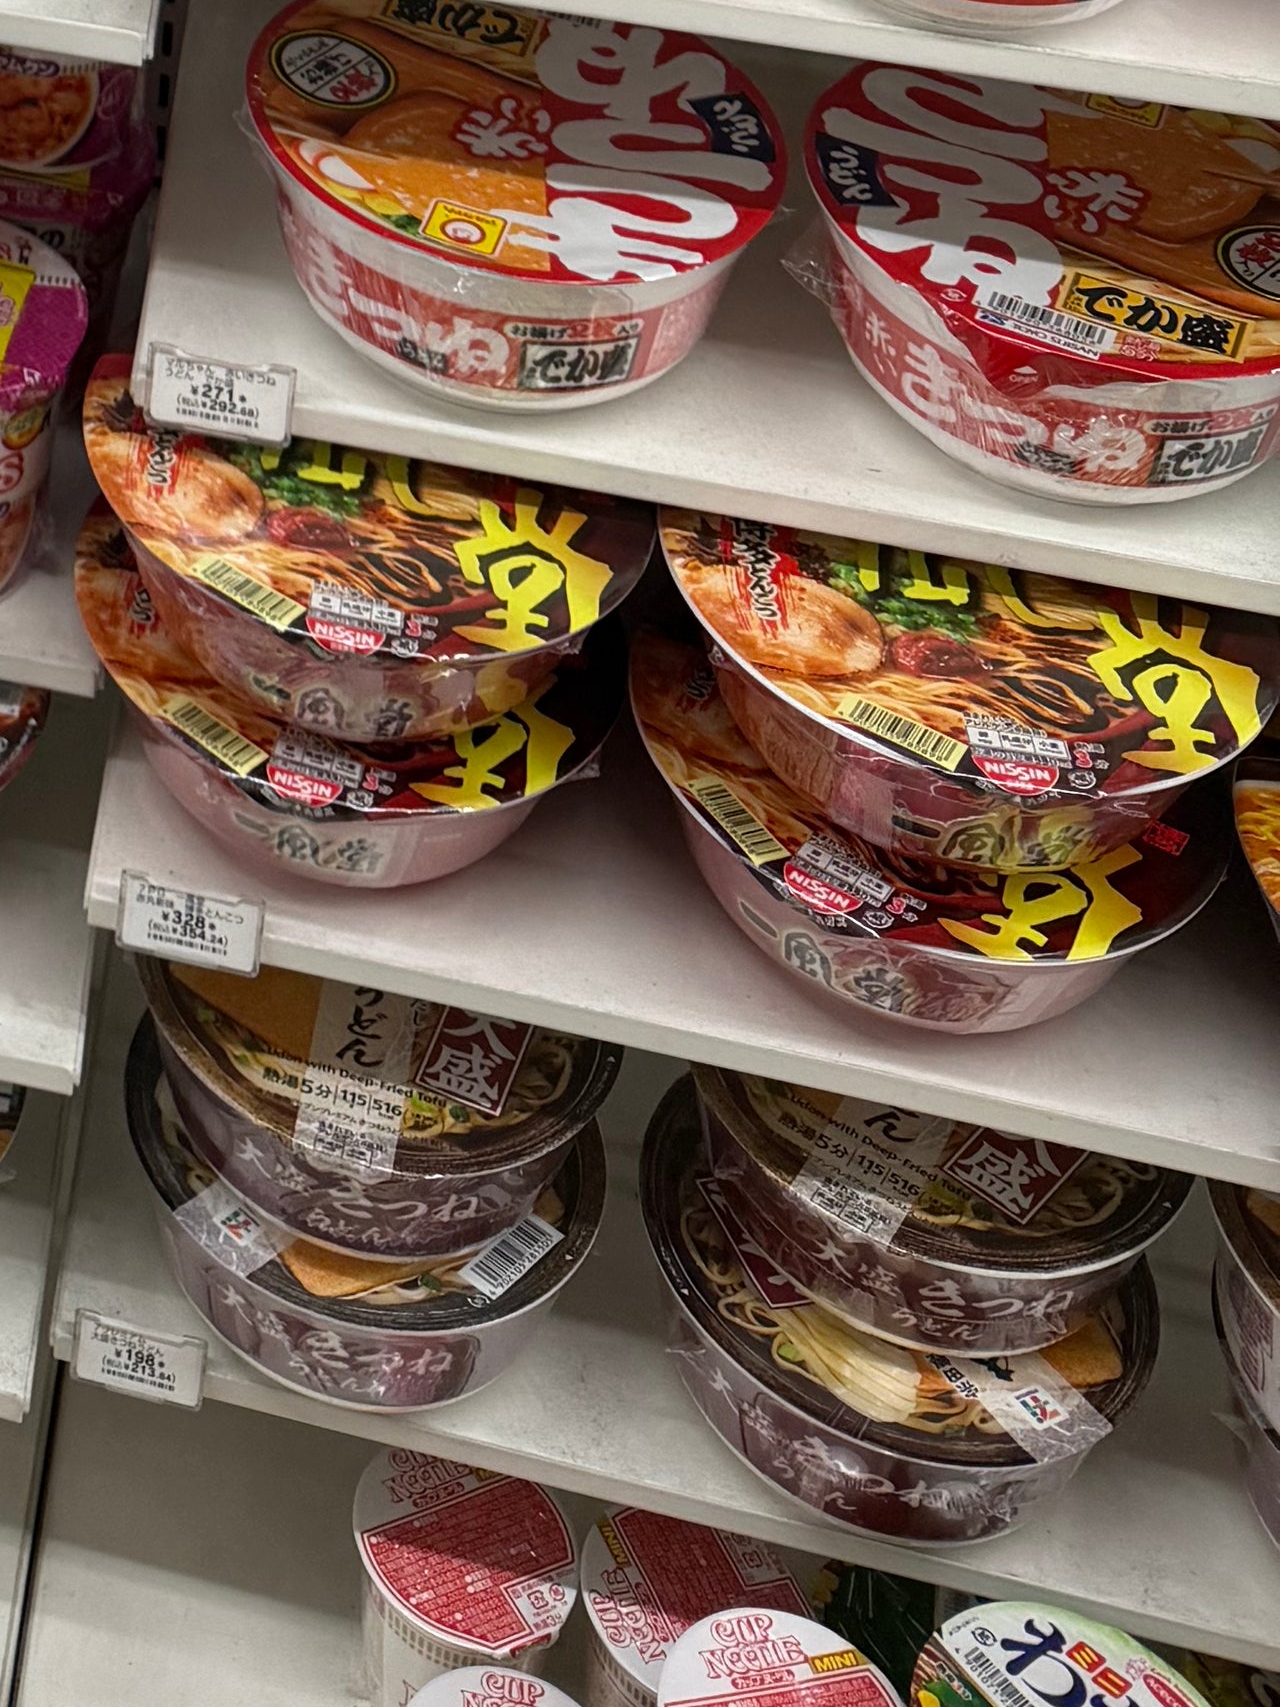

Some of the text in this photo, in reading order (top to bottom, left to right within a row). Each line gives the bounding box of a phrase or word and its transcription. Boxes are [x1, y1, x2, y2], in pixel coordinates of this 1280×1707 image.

[1076, 287, 1234, 355] でか盛
[314, 621, 376, 648] NISSIN
[273, 768, 333, 797] NISSIN
[982, 759, 1052, 784] NISSIN
[789, 868, 851, 909] NISSIN
[308, 1057, 336, 1075] with
[340, 1067, 412, 1099] Deep-Fried
[708, 1612, 775, 1643] CUP
[699, 1633, 809, 1679] NOODLE
[812, 1651, 859, 1673] MINI
